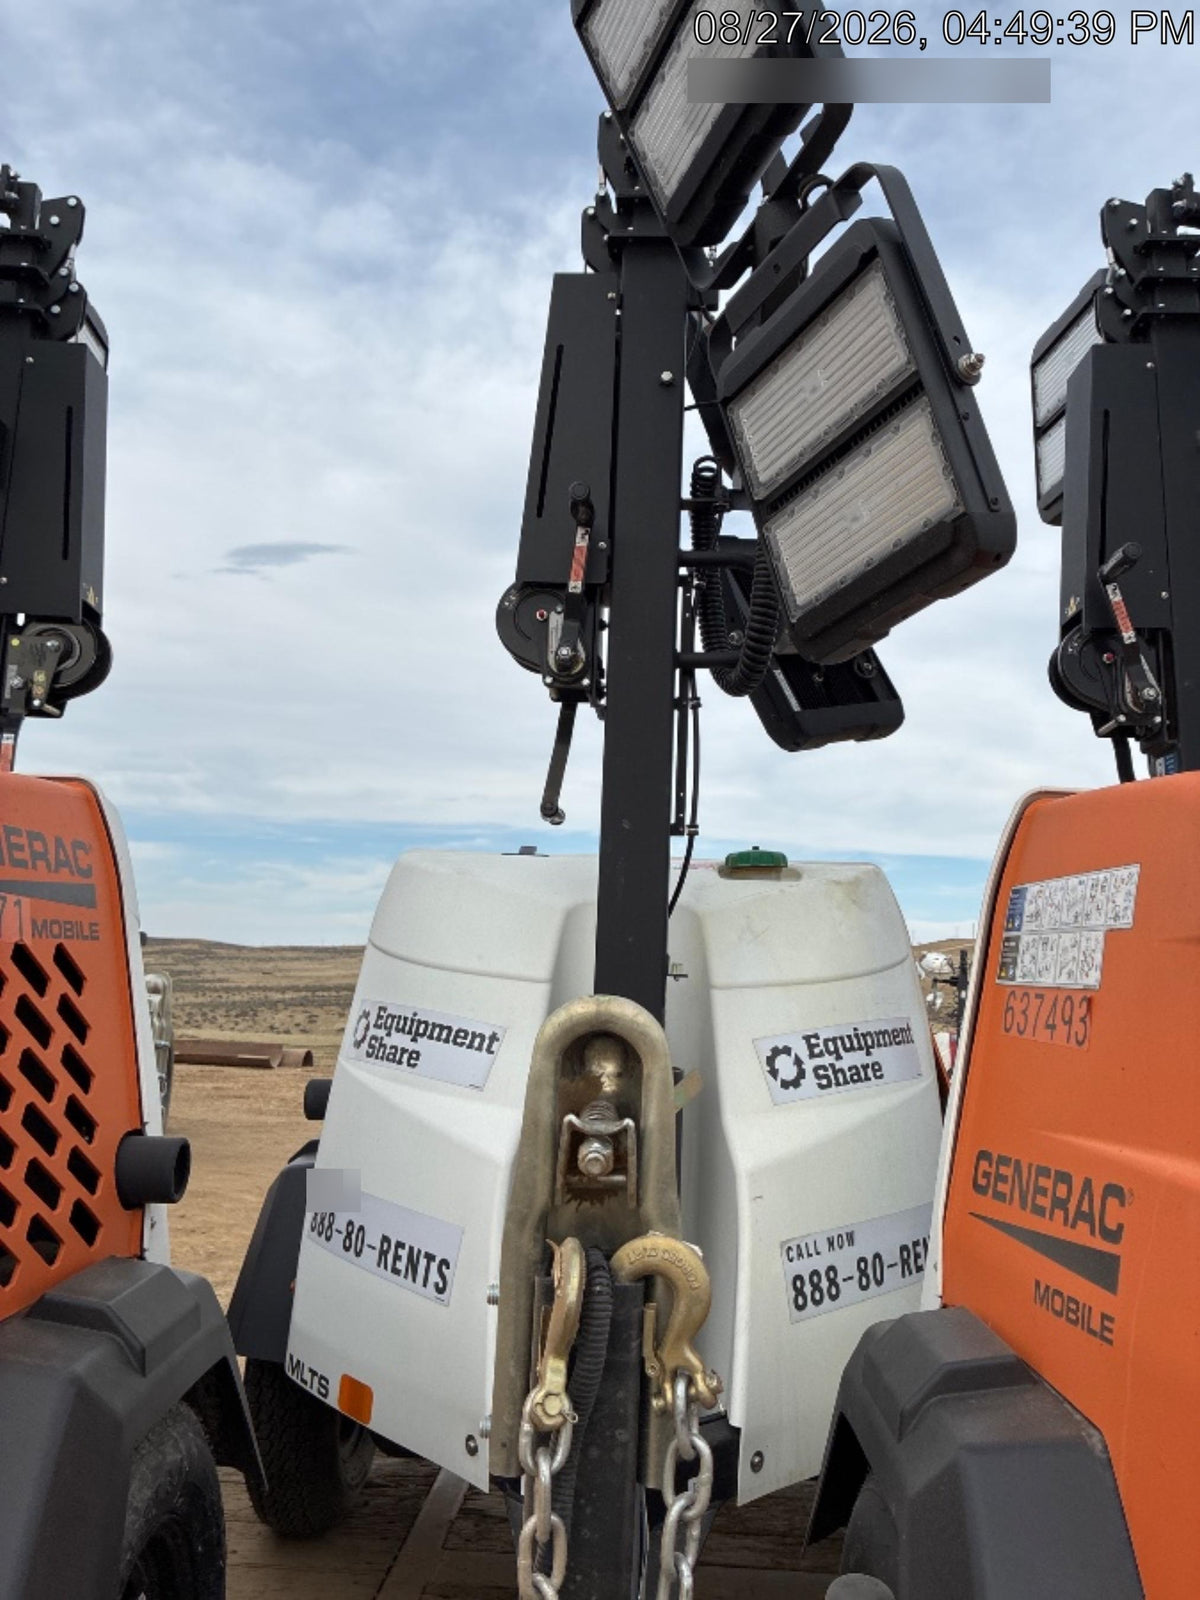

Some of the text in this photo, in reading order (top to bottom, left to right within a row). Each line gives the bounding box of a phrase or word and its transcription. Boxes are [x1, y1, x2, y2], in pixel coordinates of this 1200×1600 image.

[31, 919, 100, 941] MOBILE
[373, 1006, 500, 1055] Equipment
[802, 1023, 914, 1061] Equipment
[1003, 990, 1091, 1046] 637493
[365, 1034, 421, 1069] Share
[812, 1060, 884, 1090] Share
[972, 1149, 1126, 1245] GENERAC
[310, 1212, 451, 1295] 888-80-RENTS
[786, 1230, 855, 1263] CALL NOW
[1033, 1278, 1115, 1346] MOBILE
[287, 1352, 329, 1400] MLTS
